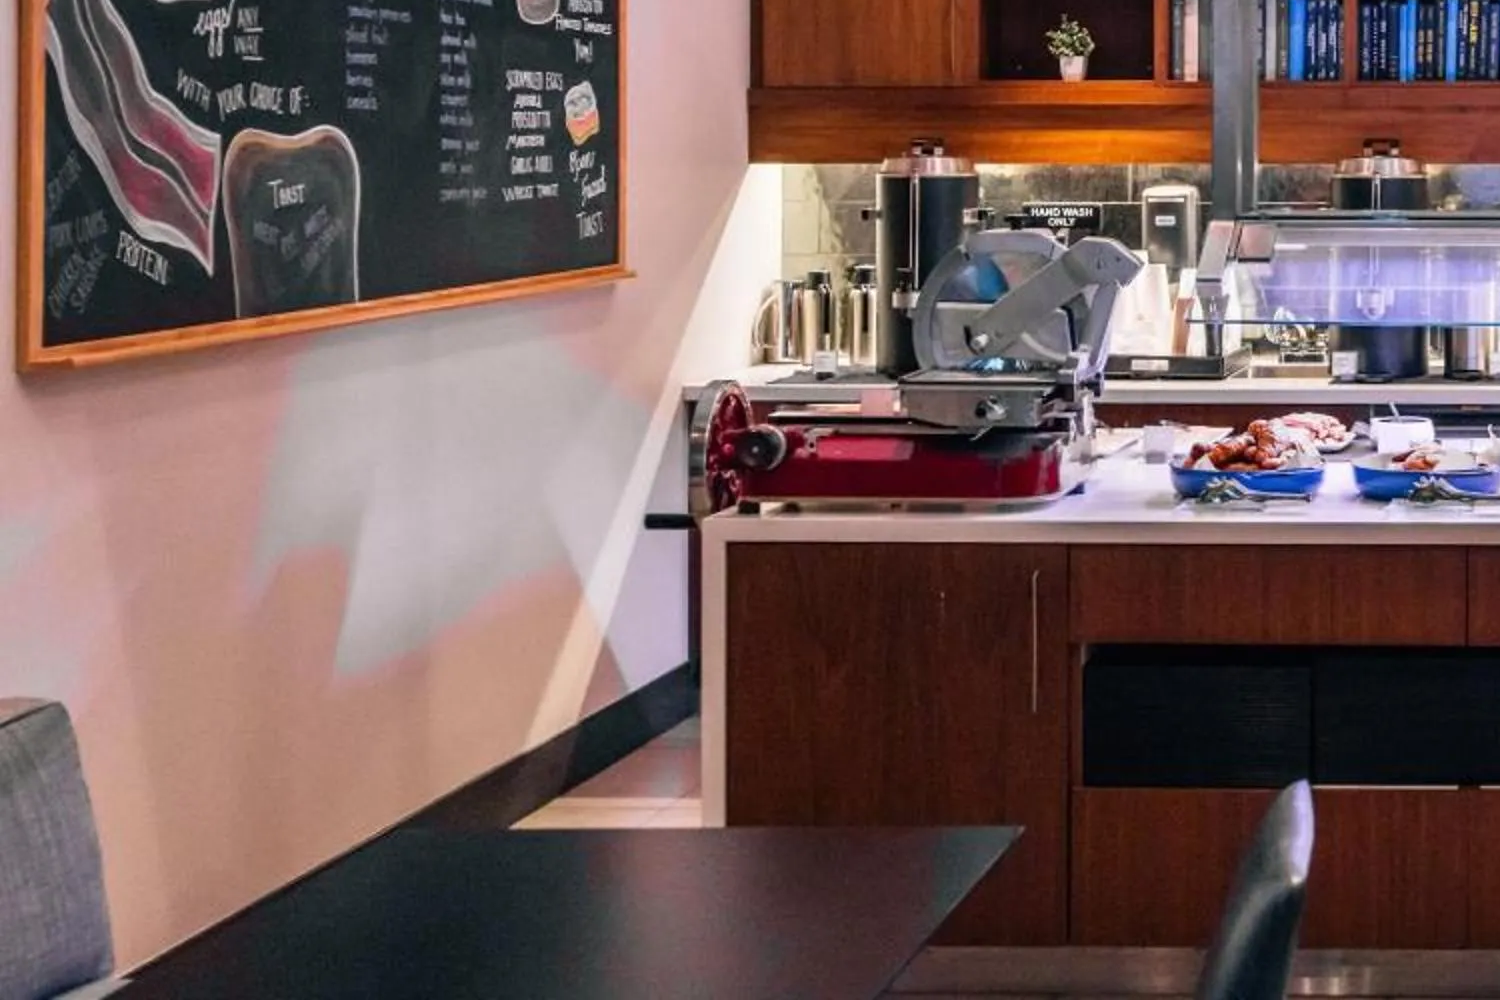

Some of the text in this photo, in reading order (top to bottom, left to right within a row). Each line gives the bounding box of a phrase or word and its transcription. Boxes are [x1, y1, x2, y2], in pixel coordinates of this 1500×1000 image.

[176, 68, 212, 113] WITH
[216, 83, 247, 122] YOUR
[249, 81, 285, 115] CHOICE
[1031, 207, 1093, 217] HAND WASH
[1047, 217, 1076, 227] ONLY
[115, 230, 169, 286] PROTEIN
